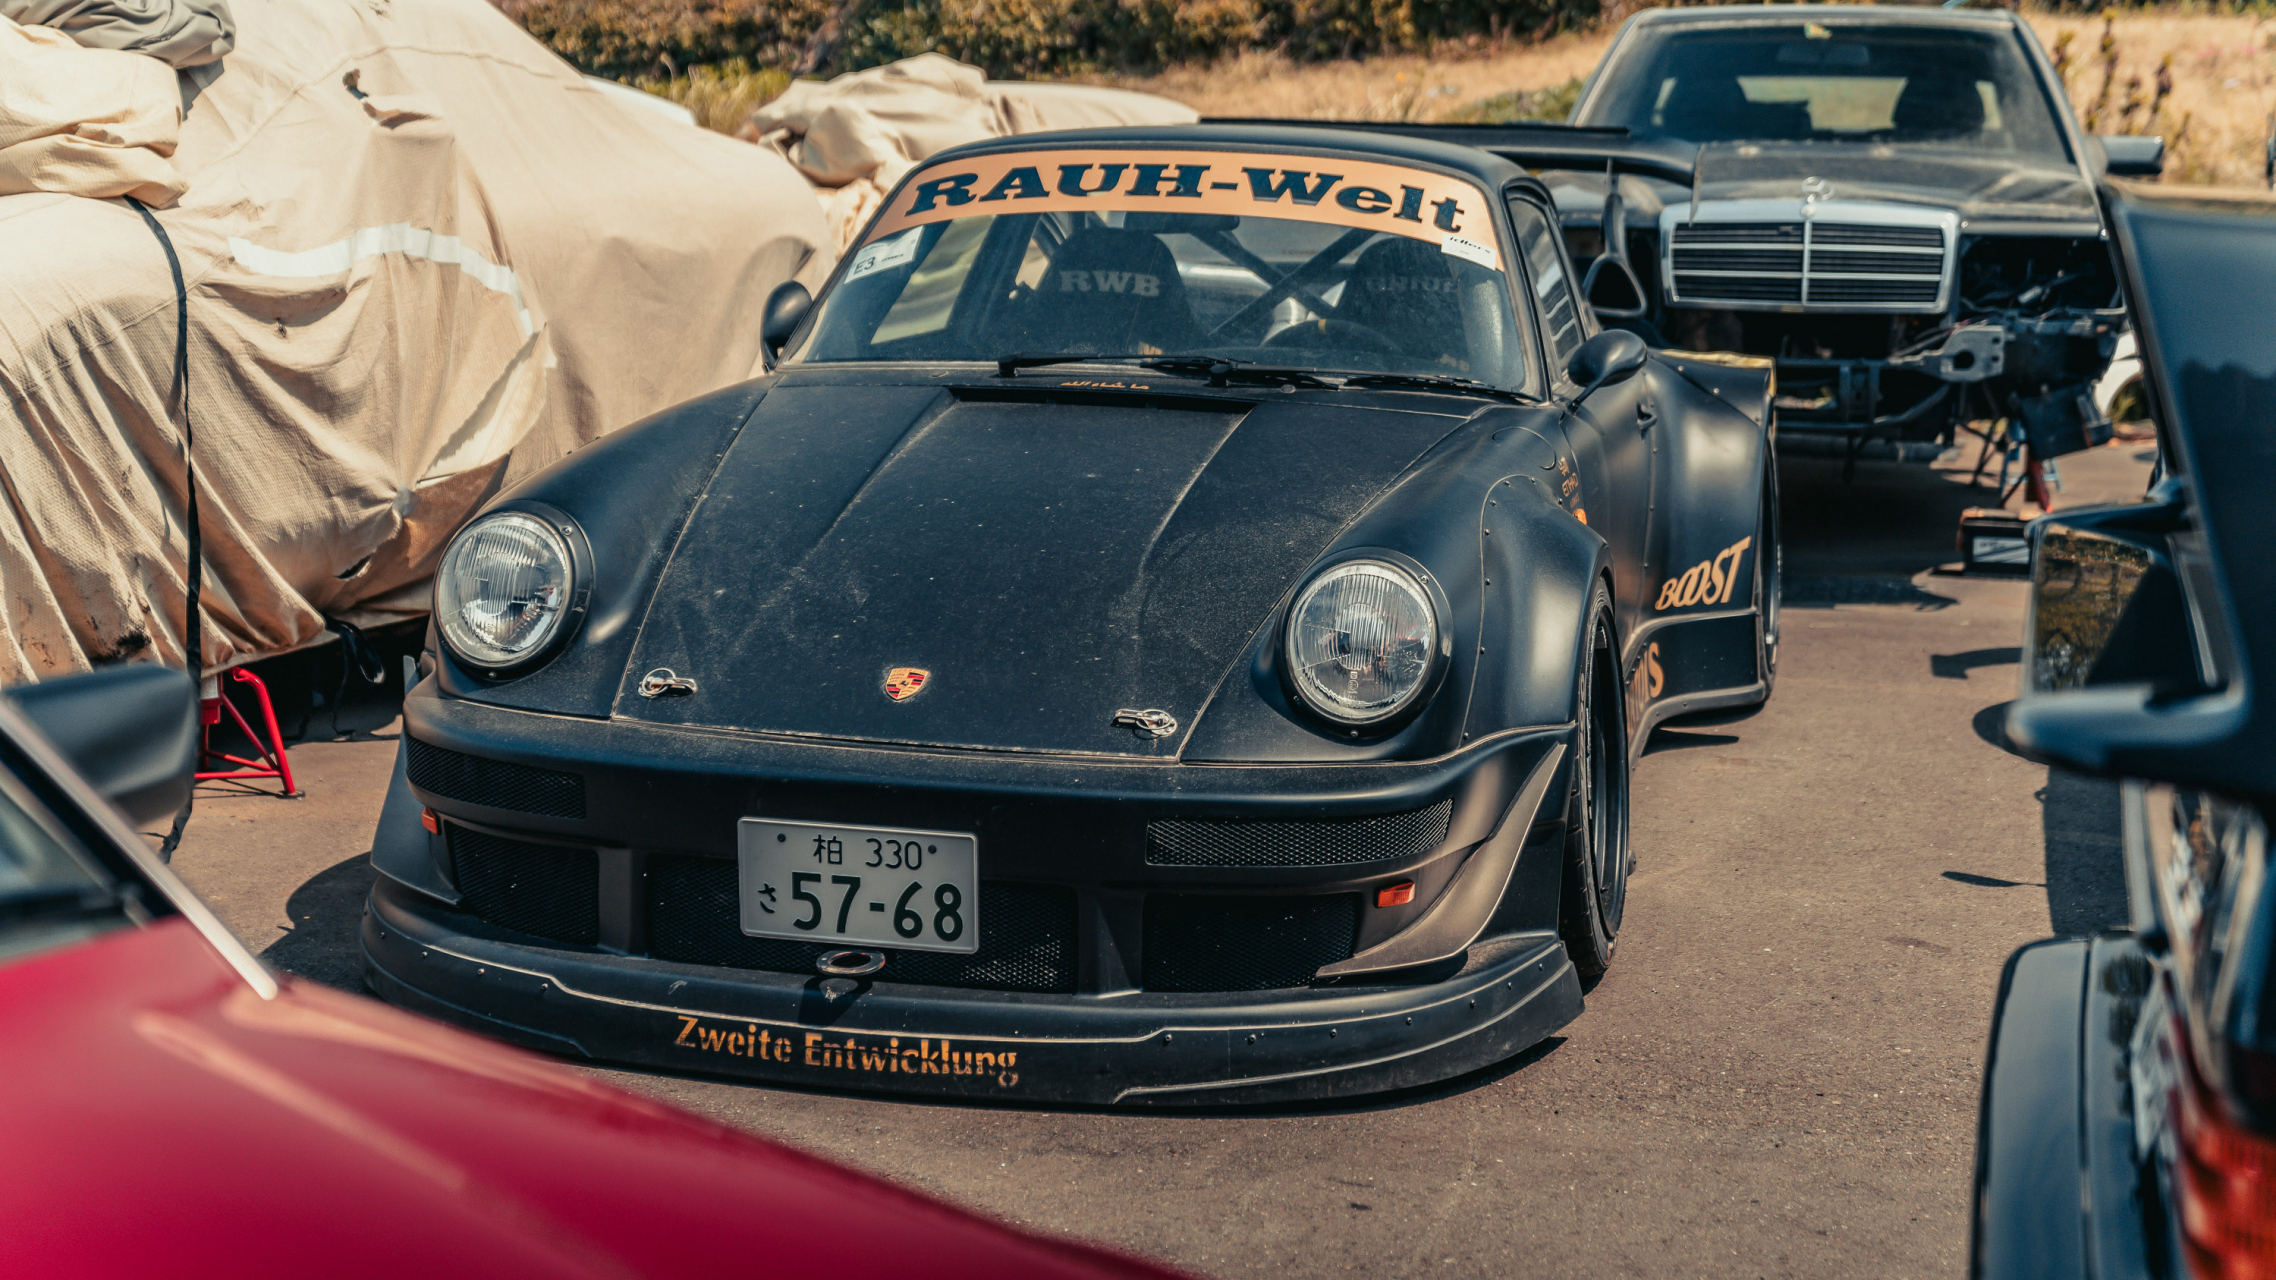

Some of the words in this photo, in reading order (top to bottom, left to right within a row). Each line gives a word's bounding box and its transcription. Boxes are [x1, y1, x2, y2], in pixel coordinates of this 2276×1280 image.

[904, 163, 1465, 232] RAUH-Welt
[853, 256, 876, 275] E3
[1059, 270, 1160, 297] RWB
[1655, 536, 1752, 611] BOOST
[813, 834, 842, 865] 柏
[865, 838, 922, 870] 330
[757, 883, 777, 914] さ
[791, 871, 964, 942] 57-68
[674, 1015, 793, 1063] Zweite
[804, 1032, 1020, 1088] Entwicklung
